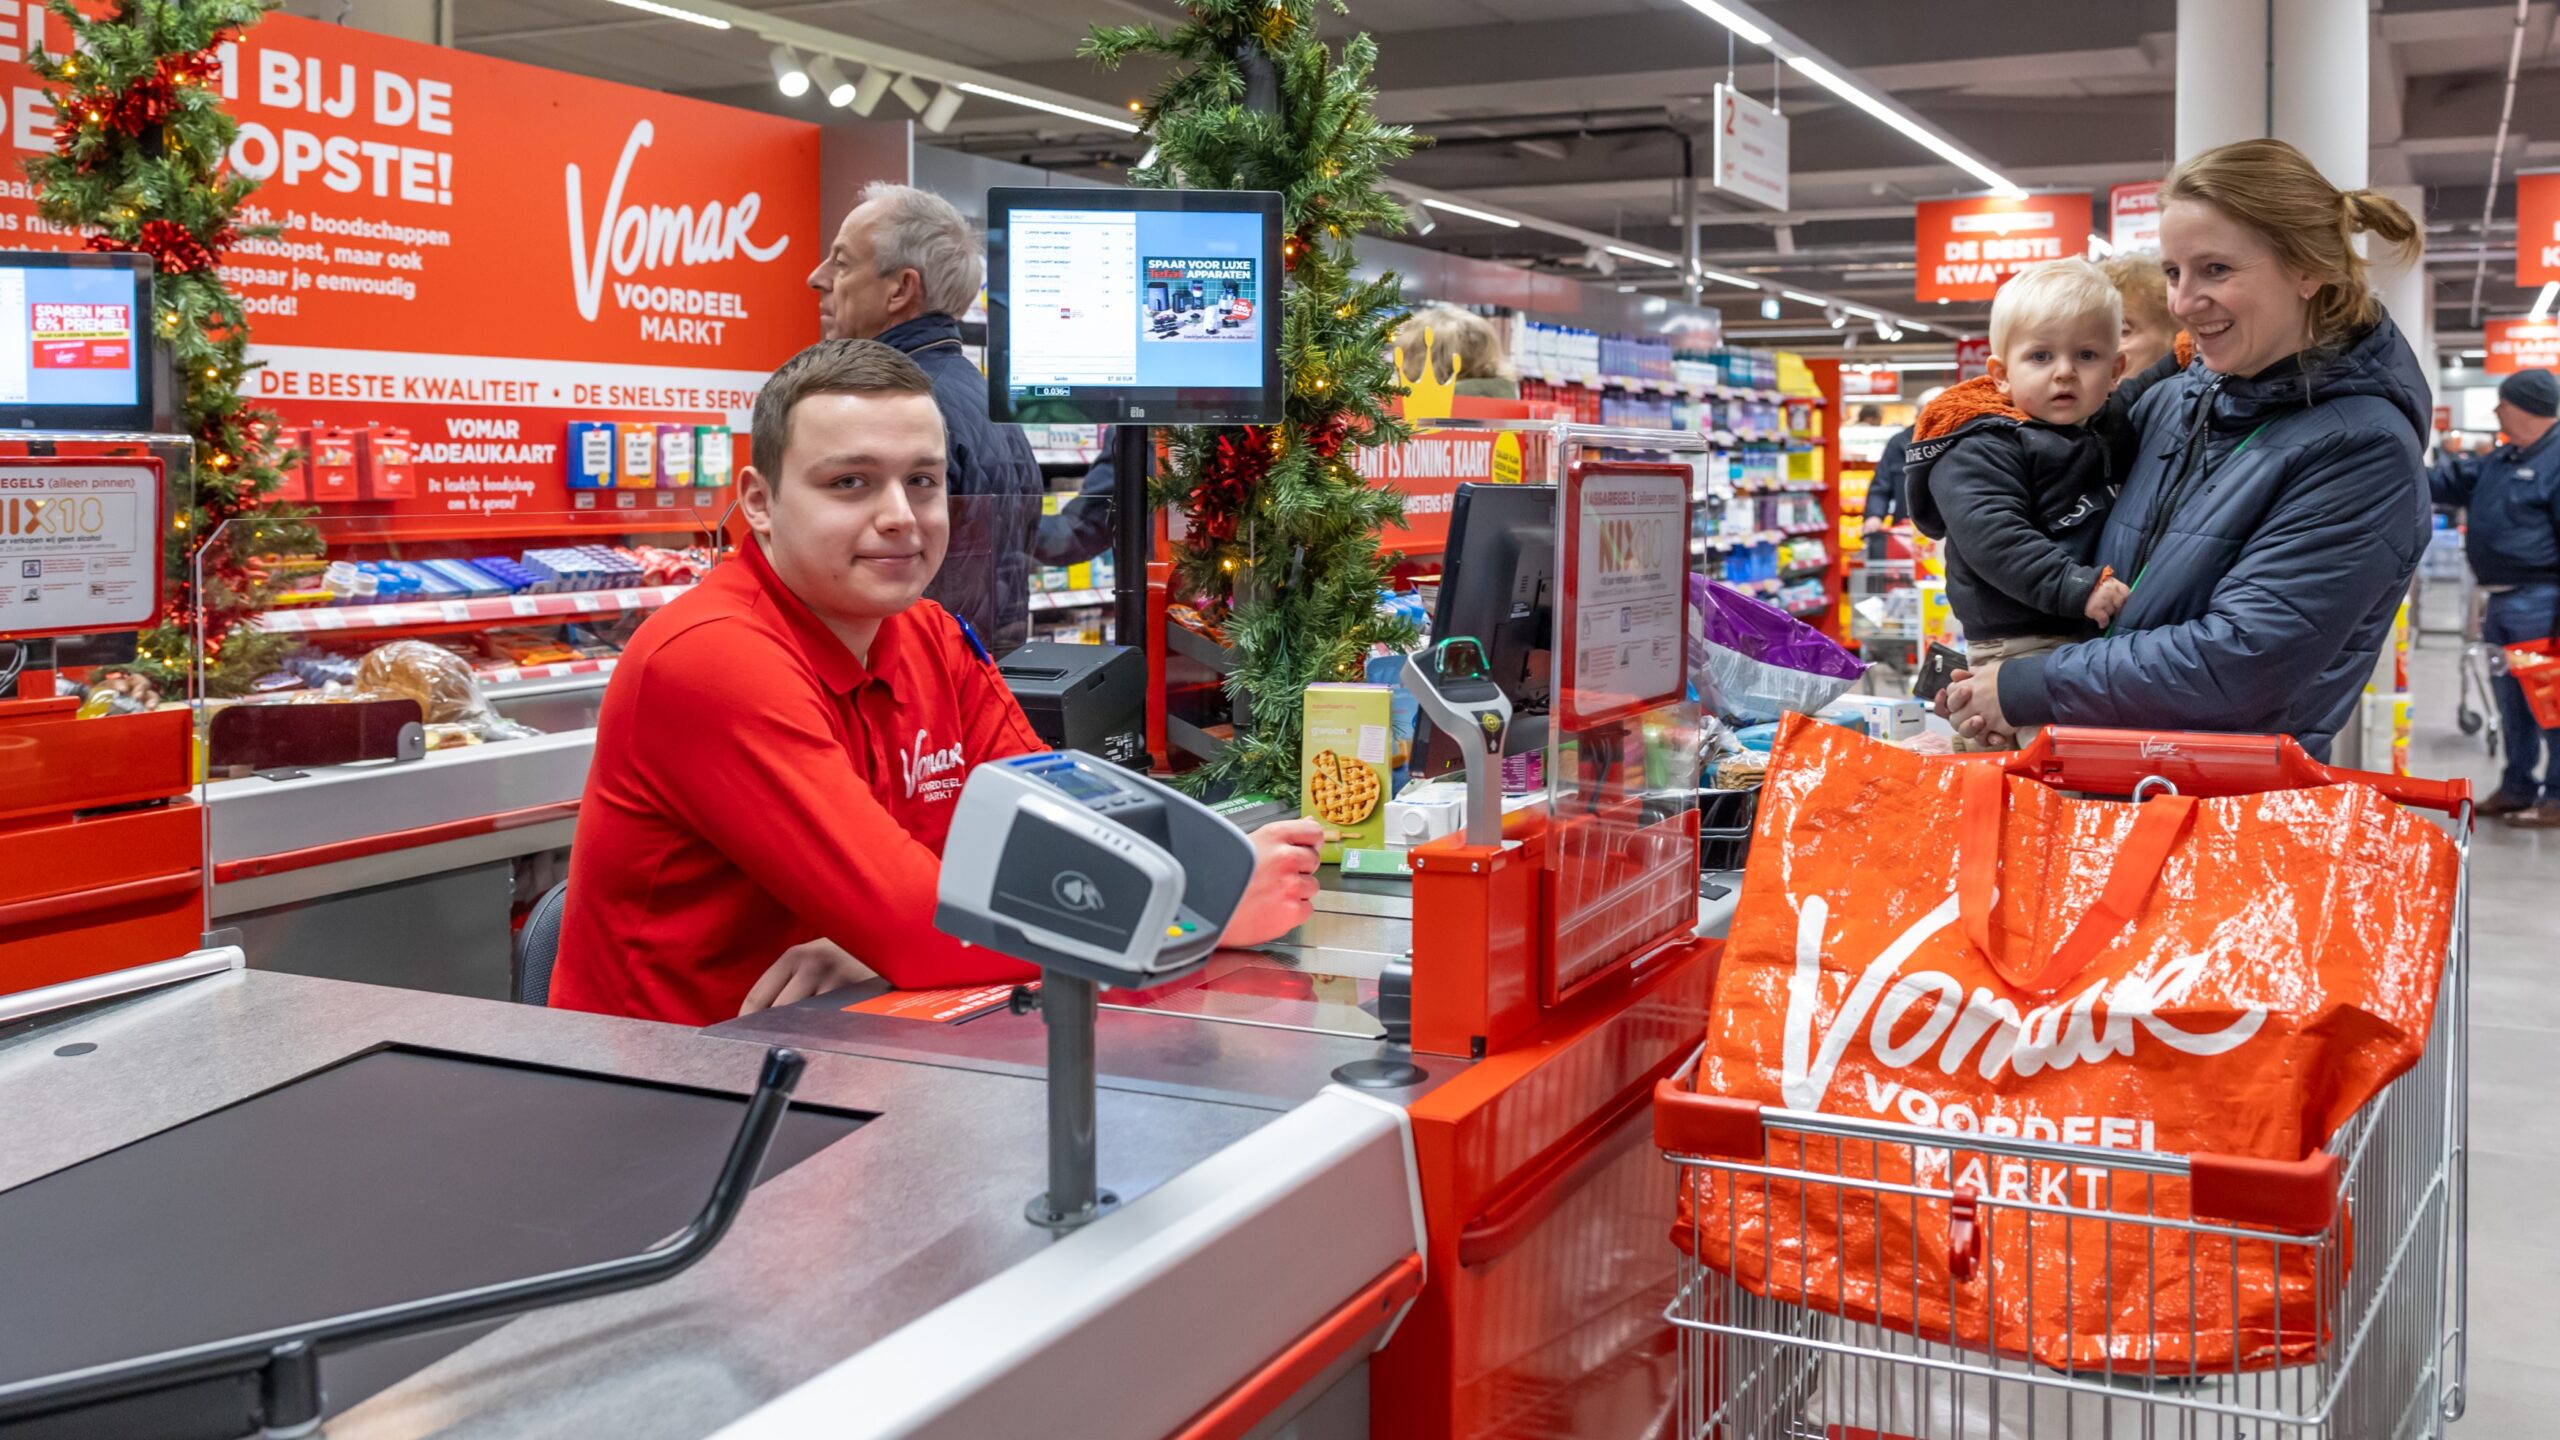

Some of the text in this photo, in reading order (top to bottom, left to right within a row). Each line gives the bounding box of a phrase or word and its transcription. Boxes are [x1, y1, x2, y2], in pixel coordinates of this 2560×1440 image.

[260, 48, 356, 119] BIJ
[374, 70, 453, 136] DE
[1726, 97, 1735, 136] 2
[218, 122, 453, 205] OPSTE!
[311, 211, 450, 246] boodschappen
[565, 118, 790, 323] Vomar
[334, 246, 384, 268] maar
[387, 251, 423, 271] ook
[1148, 260, 1250, 270] SPAAR VOOR LUXE
[1945, 238, 2062, 262] DE BESTE
[217, 264, 416, 300] espaar je eenvoudig
[1187, 270, 1251, 279] APPARATEN
[35, 304, 126, 319] SPAREN MET
[613, 282, 748, 320] VOORDEEL
[35, 318, 126, 331] 6% PREMIE!
[640, 315, 726, 346] MARKT
[260, 370, 758, 411] DE BESTE KWALITEIT DE SNELSTE SERV
[446, 418, 520, 439] VOMAR
[1403, 439, 1450, 478] KONING
[1453, 440, 1491, 477] KAART
[0, 477, 135, 490] EGELS (alleen pinnen)
[0, 496, 104, 536] IX18
[900, 729, 965, 799] Vomar
[1781, 887, 2268, 1113] Vomar
